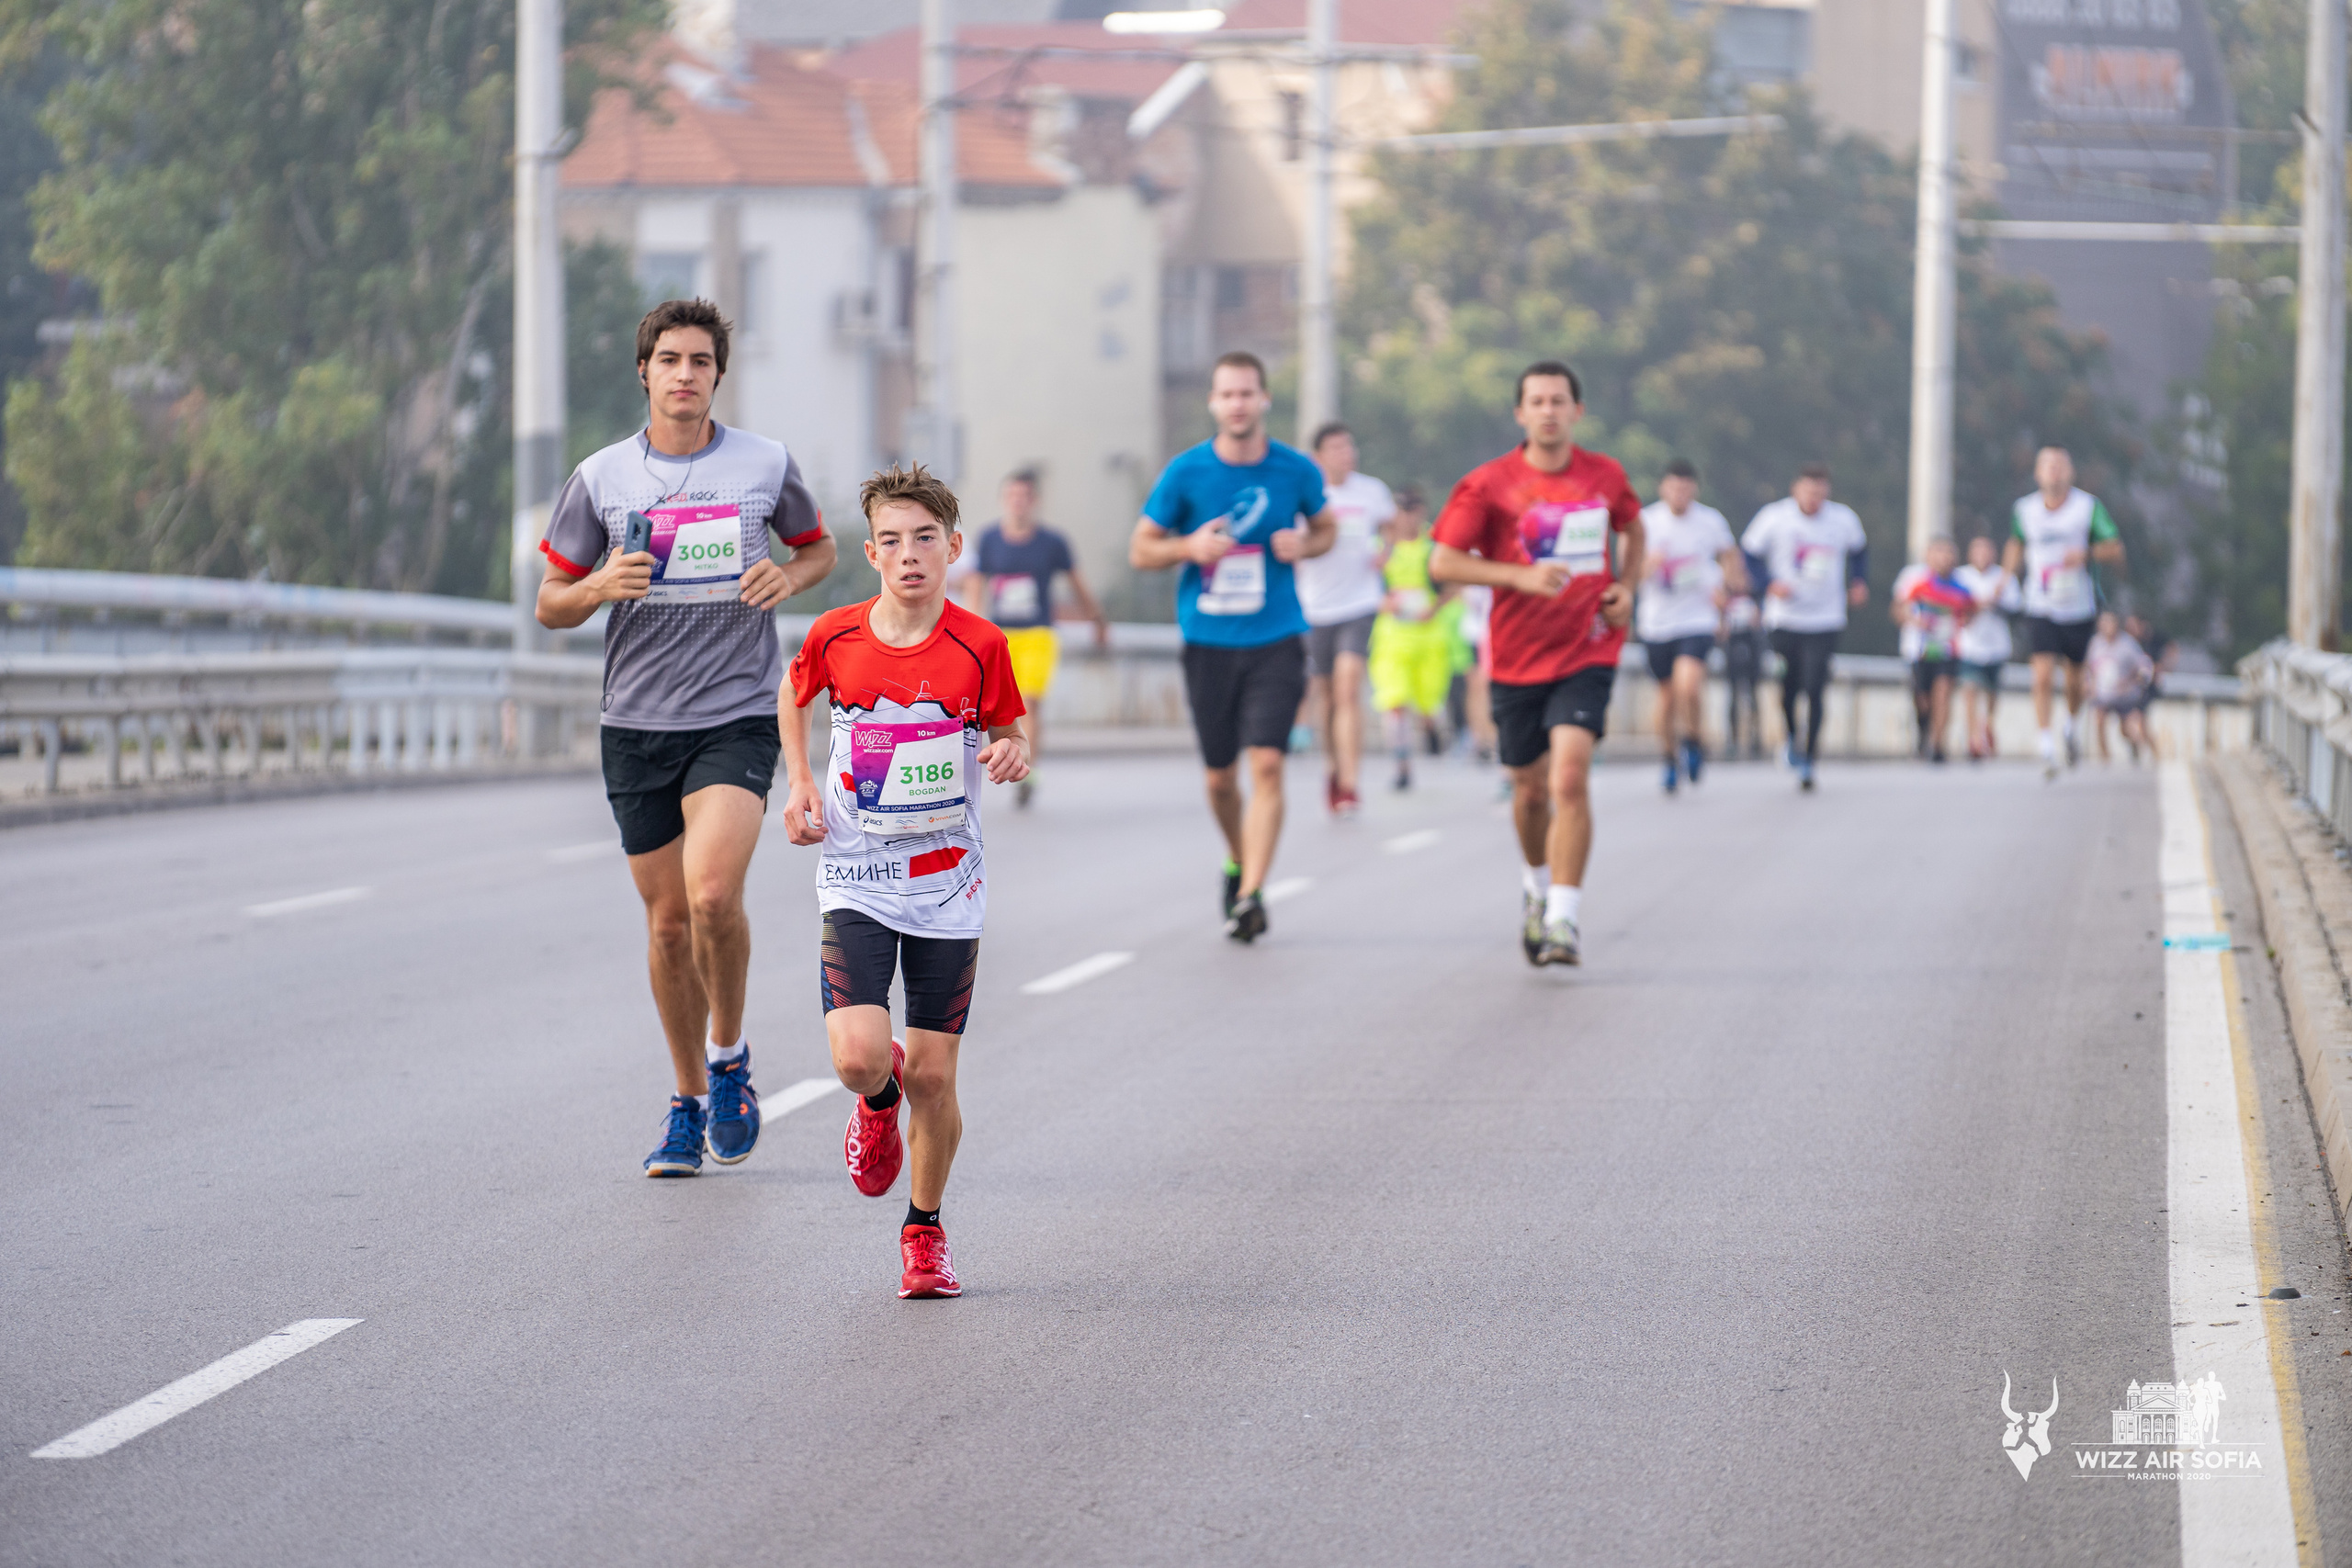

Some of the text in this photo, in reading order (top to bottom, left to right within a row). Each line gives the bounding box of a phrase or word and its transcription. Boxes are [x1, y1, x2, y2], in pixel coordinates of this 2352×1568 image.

[690, 491, 718, 501] ROCK
[678, 542, 735, 561] 3006
[899, 761, 954, 784] 3186
[909, 785, 946, 796] BOGDAN
[909, 802, 942, 811] MARATHON
[942, 799, 956, 807] 2020
[935, 812, 962, 821] VIVACOM
[825, 862, 902, 882] ЕМИНЕ
